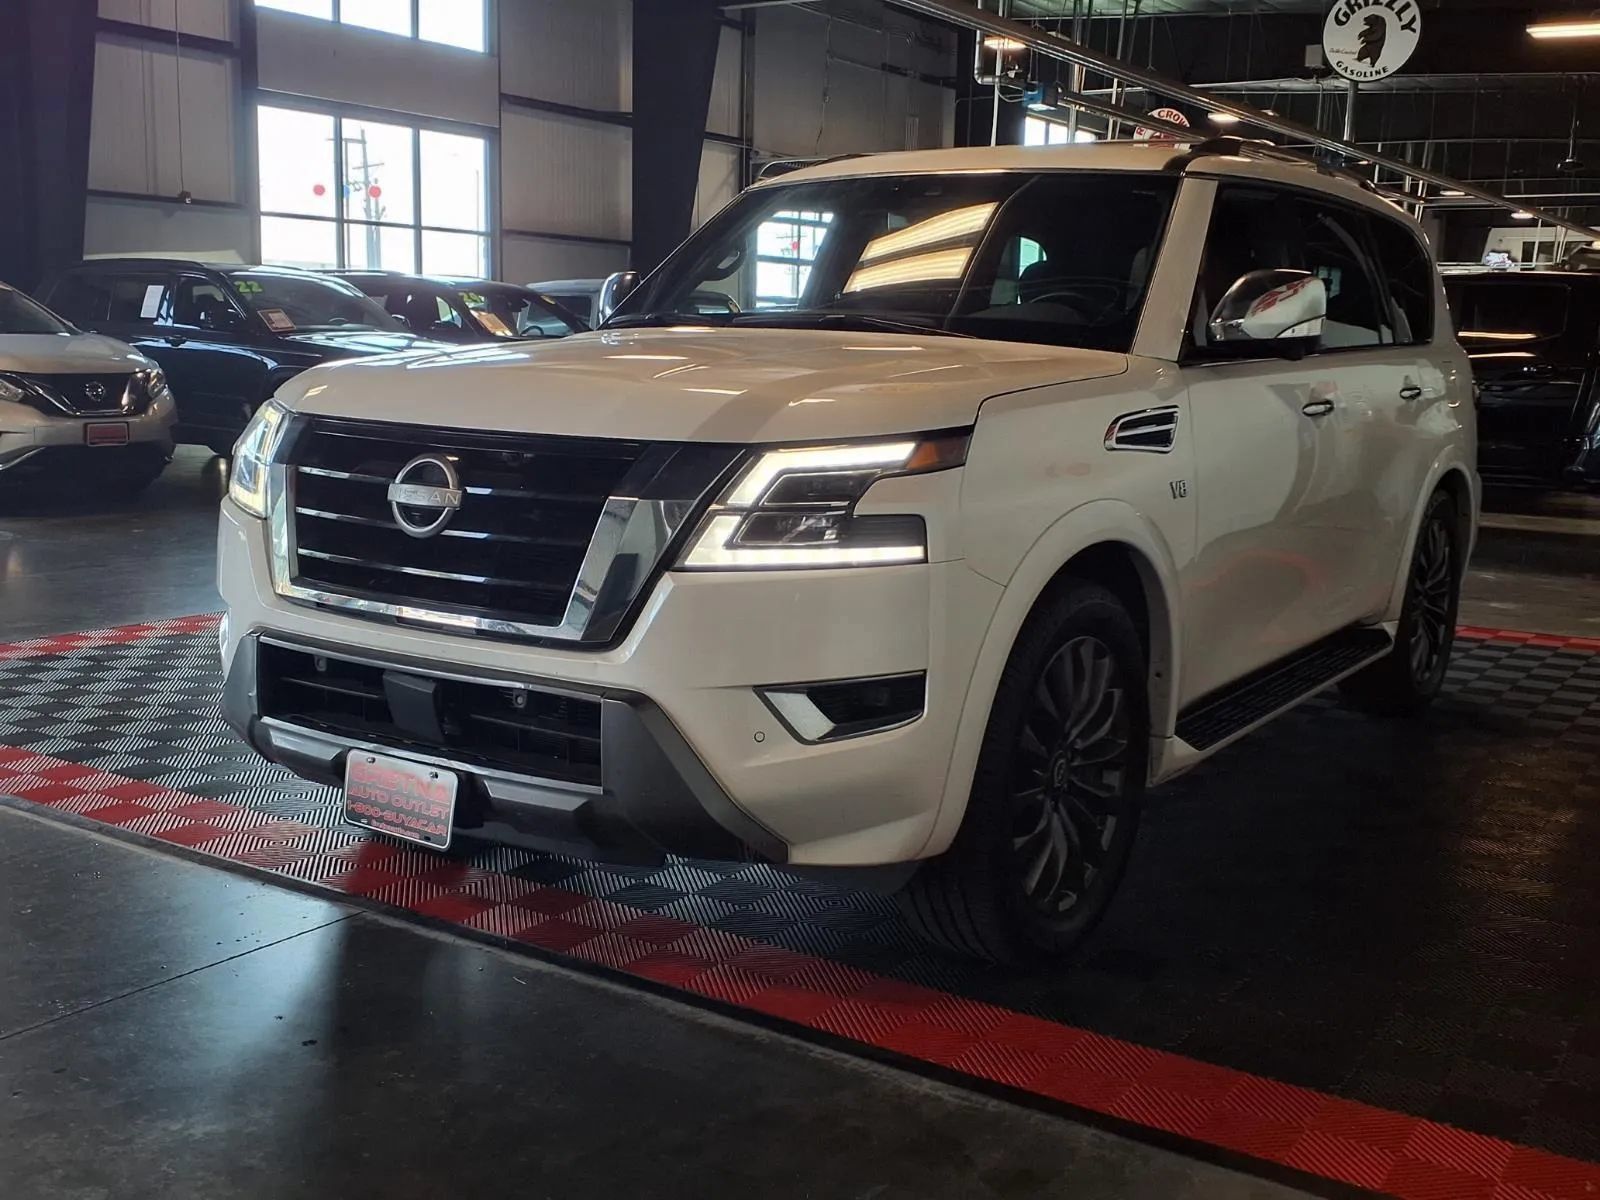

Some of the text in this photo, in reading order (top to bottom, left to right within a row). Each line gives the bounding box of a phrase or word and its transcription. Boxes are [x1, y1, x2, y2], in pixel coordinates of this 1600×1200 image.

[1336, 60, 1389, 78] GASOLINE
[234, 281, 263, 293] 22
[1169, 479, 1187, 500] V8
[348, 785, 450, 820] AUTO OUTLET
